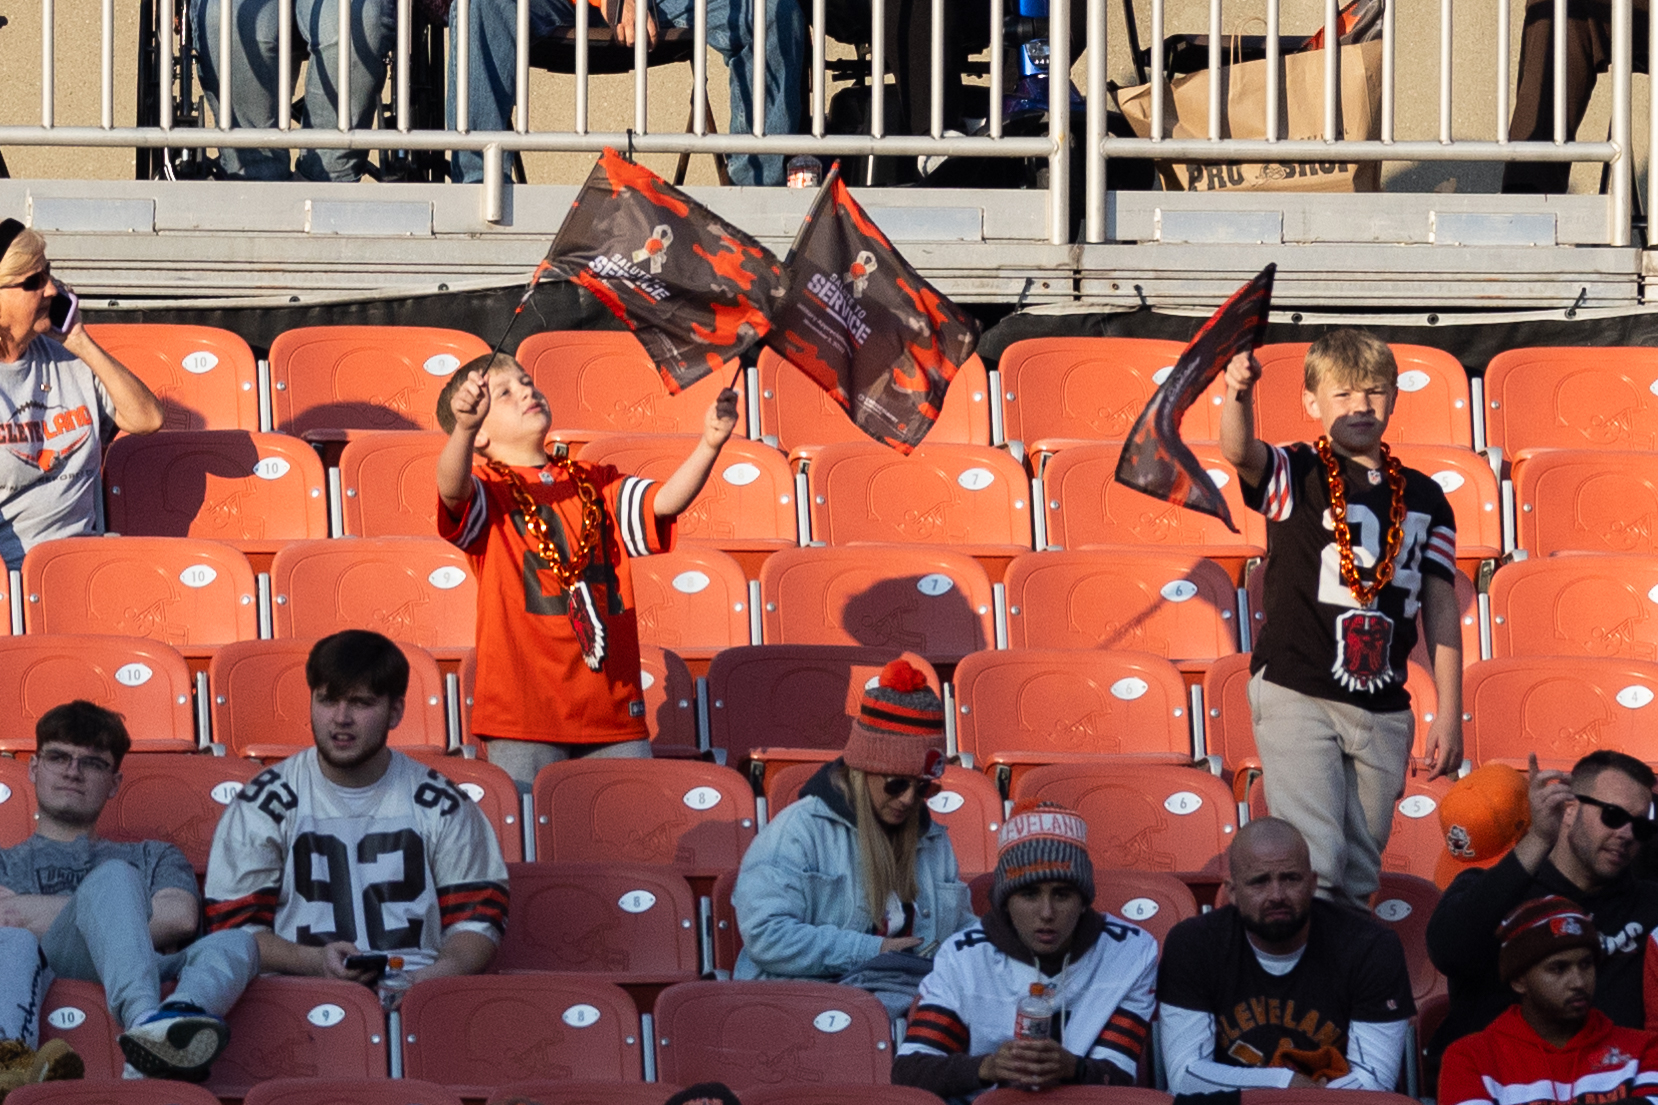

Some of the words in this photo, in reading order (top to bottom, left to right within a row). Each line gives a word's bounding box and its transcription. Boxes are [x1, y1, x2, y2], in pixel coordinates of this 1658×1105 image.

[807, 273, 872, 345] SERVICE
[854, 306, 867, 319] TO
[194, 357, 207, 369] 10
[1408, 376, 1415, 388] 5
[265, 463, 279, 475] 10
[972, 474, 979, 486] 7
[1441, 476, 1449, 489] 5
[1318, 504, 1432, 619] 24
[192, 571, 206, 583] 10
[442, 572, 451, 583] 9
[931, 579, 939, 592] 7
[1175, 585, 1183, 597] 6
[127, 669, 141, 682] 10
[1125, 683, 1133, 696] 6
[1631, 691, 1639, 703] 4
[223, 787, 238, 799] 10
[237, 768, 298, 824] 92
[698, 792, 706, 805] 8
[942, 797, 949, 809] 7
[1179, 798, 1188, 810] 6
[1413, 801, 1421, 813] 5
[292, 828, 426, 951] 92
[633, 896, 641, 909] 8
[1136, 904, 1144, 916] 6
[1389, 904, 1397, 917] 5
[60, 1012, 75, 1025] 10
[321, 1010, 330, 1022] 9
[577, 1010, 585, 1023] 8
[828, 1016, 836, 1028] 7
